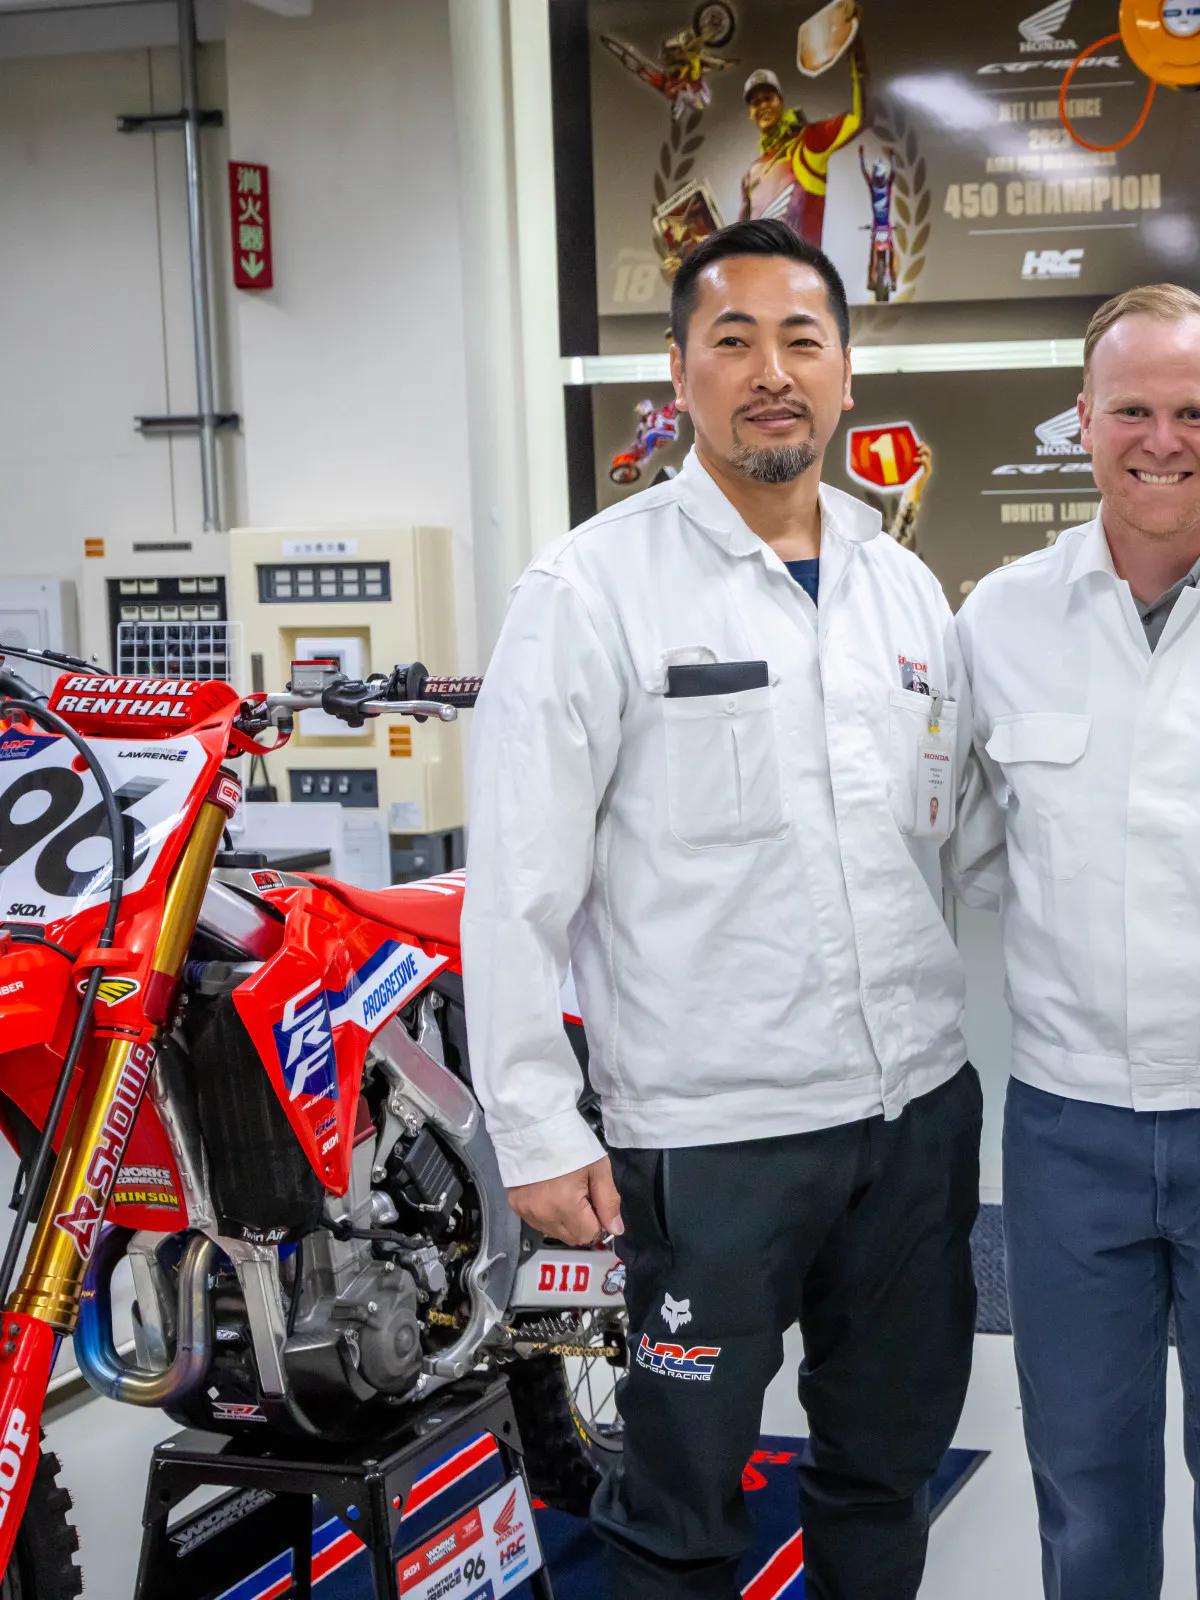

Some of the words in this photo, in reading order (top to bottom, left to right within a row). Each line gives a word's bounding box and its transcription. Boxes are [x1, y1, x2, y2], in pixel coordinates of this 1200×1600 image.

[1019, 39, 1077, 53] HONDA
[237, 166, 264, 252] 消火器
[944, 183, 999, 218] 450
[1005, 174, 1162, 216] CHAMPION
[1022, 249, 1085, 275] HRC
[614, 263, 660, 303] 18
[869, 433, 900, 485] 1
[1001, 503, 1054, 523] HUNTER
[63, 676, 196, 697] RENTHAL
[55, 695, 188, 718] RENTHAL
[117, 751, 187, 762] LAWRENCE
[923, 752, 950, 762] HONDA
[0, 766, 169, 897] 96
[6, 902, 46, 918] SKDA
[362, 952, 419, 1025] PROGRESSIVE
[281, 977, 332, 1102] CRF
[321, 1132, 340, 1156] SKDA
[114, 1192, 179, 1205] HINSON
[242, 1226, 264, 1242] Twin
[265, 1227, 287, 1241] Air
[636, 1332, 722, 1374] HRC
[635, 1356, 667, 1377] Honda
[667, 1369, 712, 1382] RACING
[495, 1521, 524, 1547] HONDA
[499, 1533, 526, 1567] HRC
[402, 1561, 421, 1581] SKDA
[463, 1549, 487, 1588] 96
[426, 1572, 454, 1595] HUNTER
